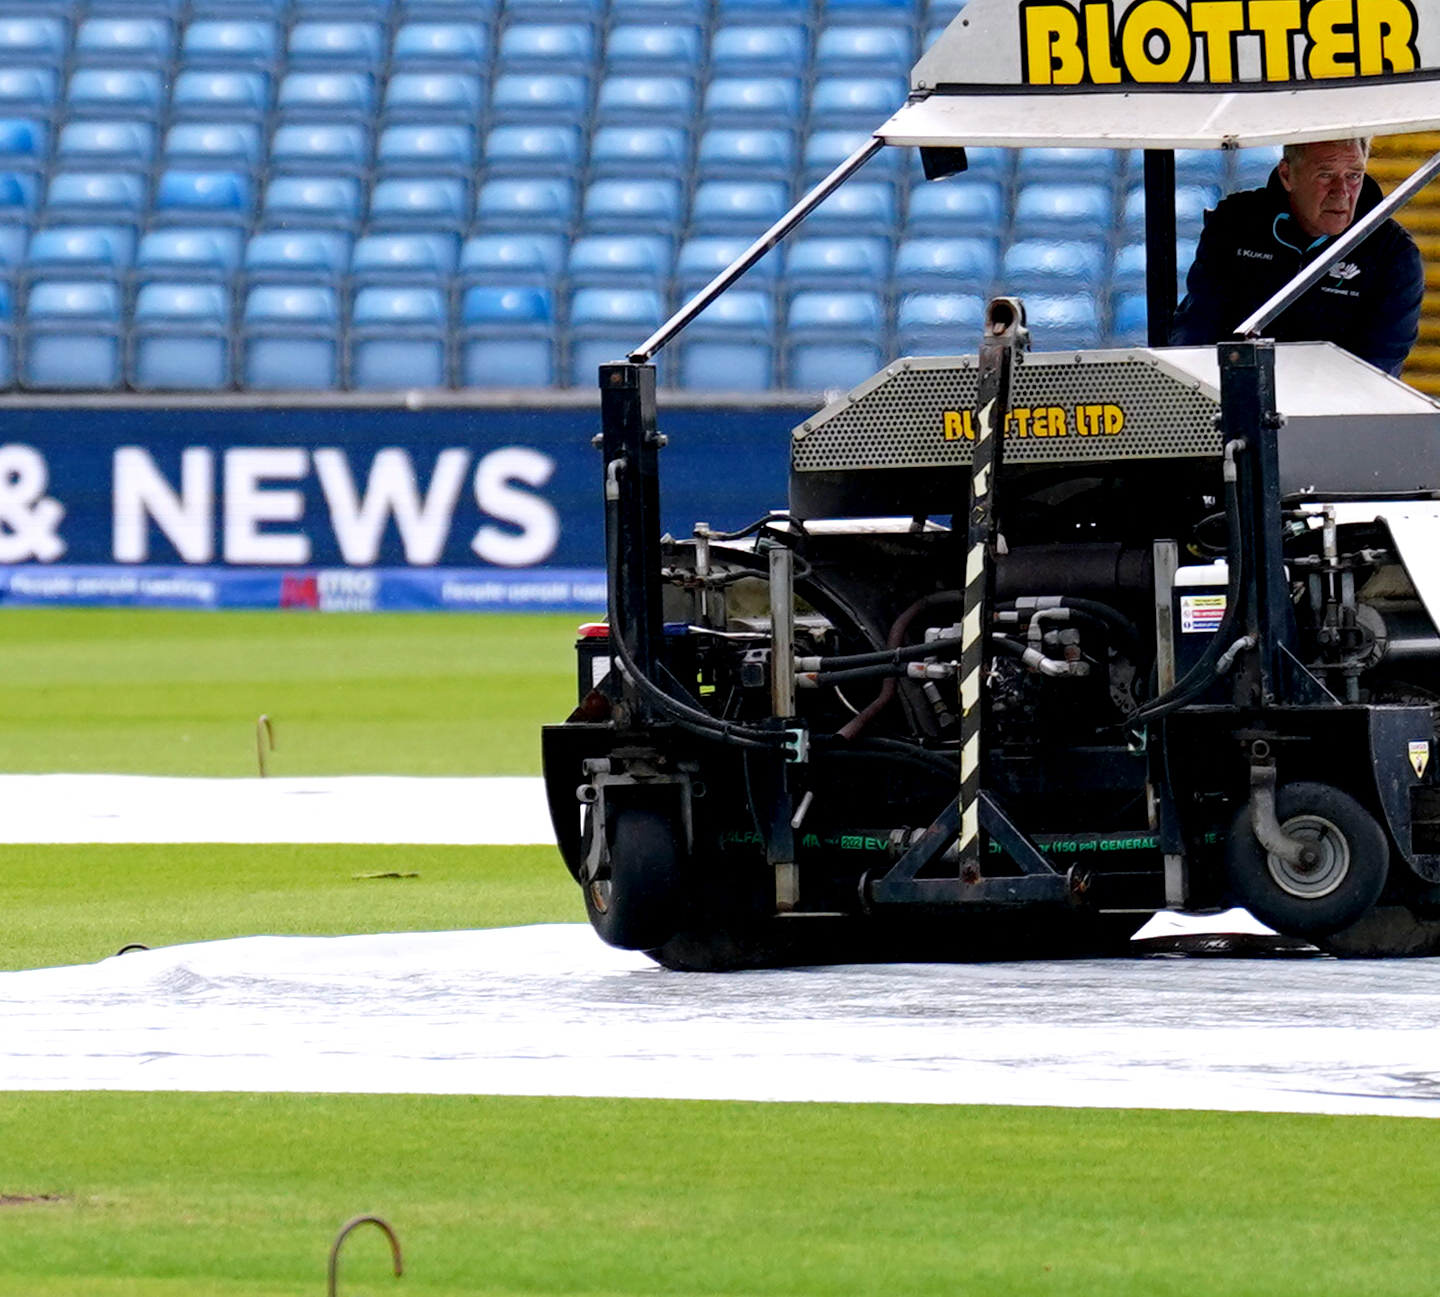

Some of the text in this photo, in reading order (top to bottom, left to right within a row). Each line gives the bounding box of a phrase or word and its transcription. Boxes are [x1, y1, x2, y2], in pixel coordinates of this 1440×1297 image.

[1074, 403, 1125, 438] LTD
[111, 444, 560, 567] NEWS
[841, 835, 863, 850] 202
[1052, 841, 1077, 853] (150
[1079, 840, 1098, 853] psi)
[1099, 836, 1157, 852] GENERAL
